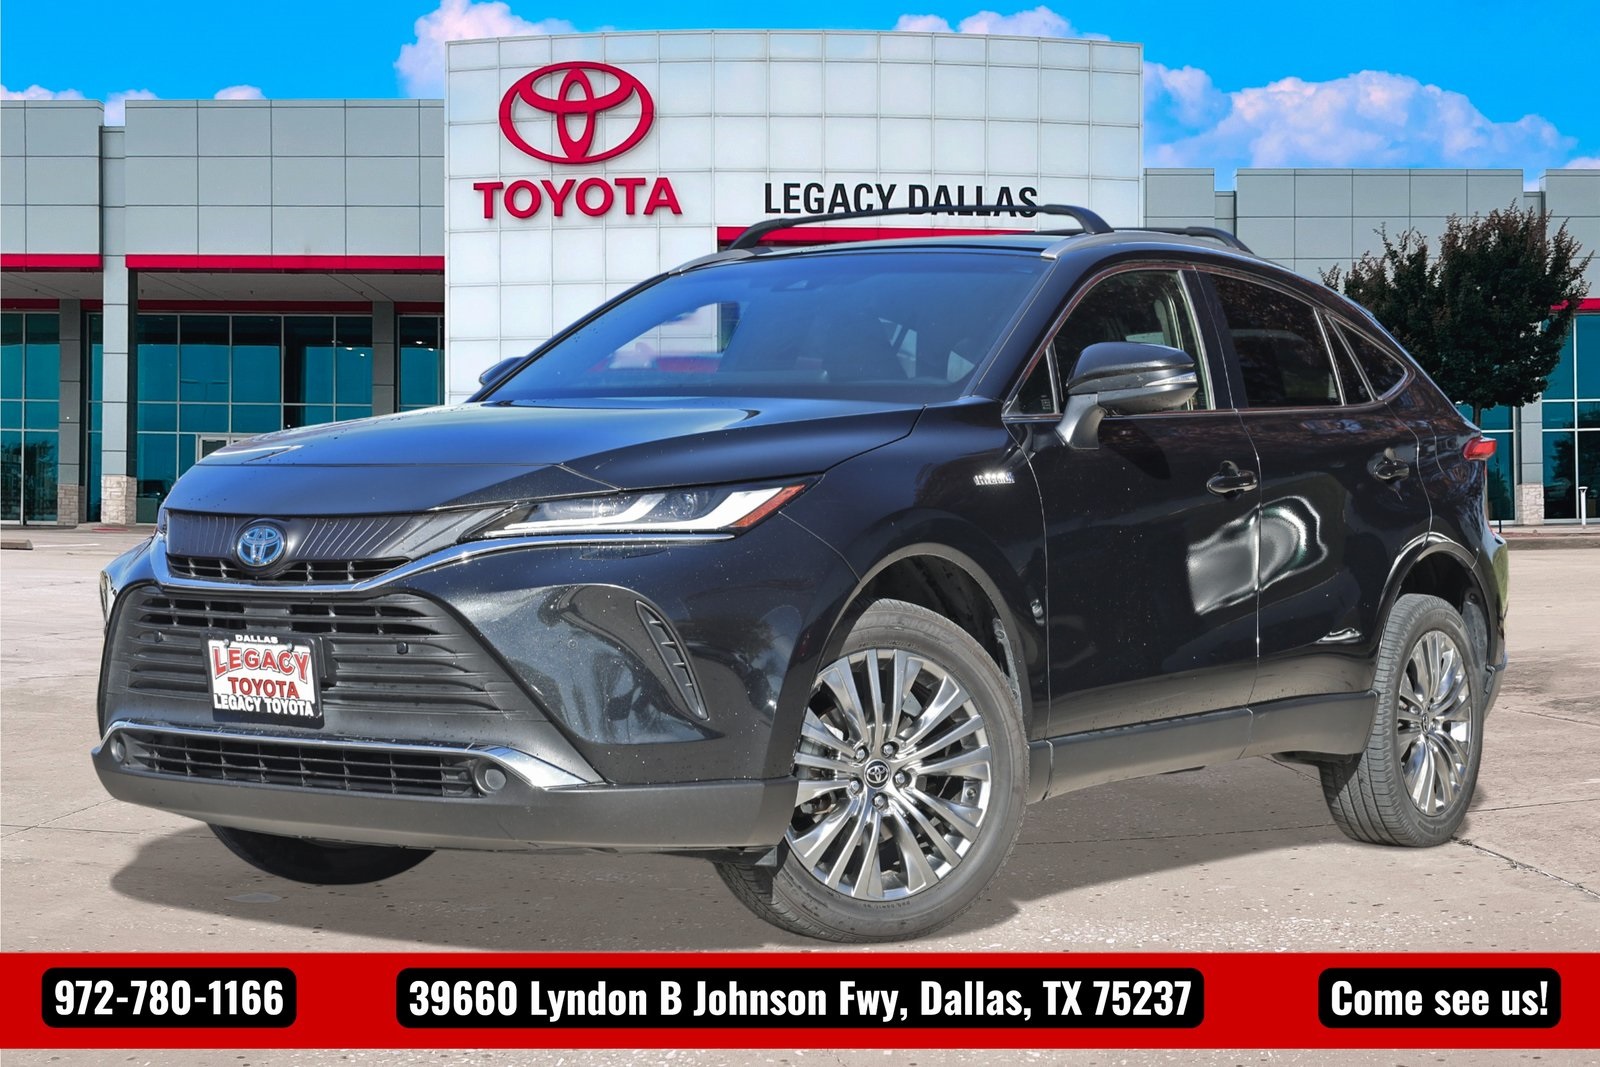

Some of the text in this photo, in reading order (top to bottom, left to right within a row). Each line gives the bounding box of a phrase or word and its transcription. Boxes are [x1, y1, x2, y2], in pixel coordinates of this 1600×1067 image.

[473, 177, 683, 219] TOYOTA
[764, 182, 1038, 218] LEGACY DALLAS
[235, 634, 279, 644] DALLAS
[212, 646, 310, 684] LEGACY
[228, 677, 300, 699] TOYOTA
[214, 694, 314, 717] LEGACY TOYOTA
